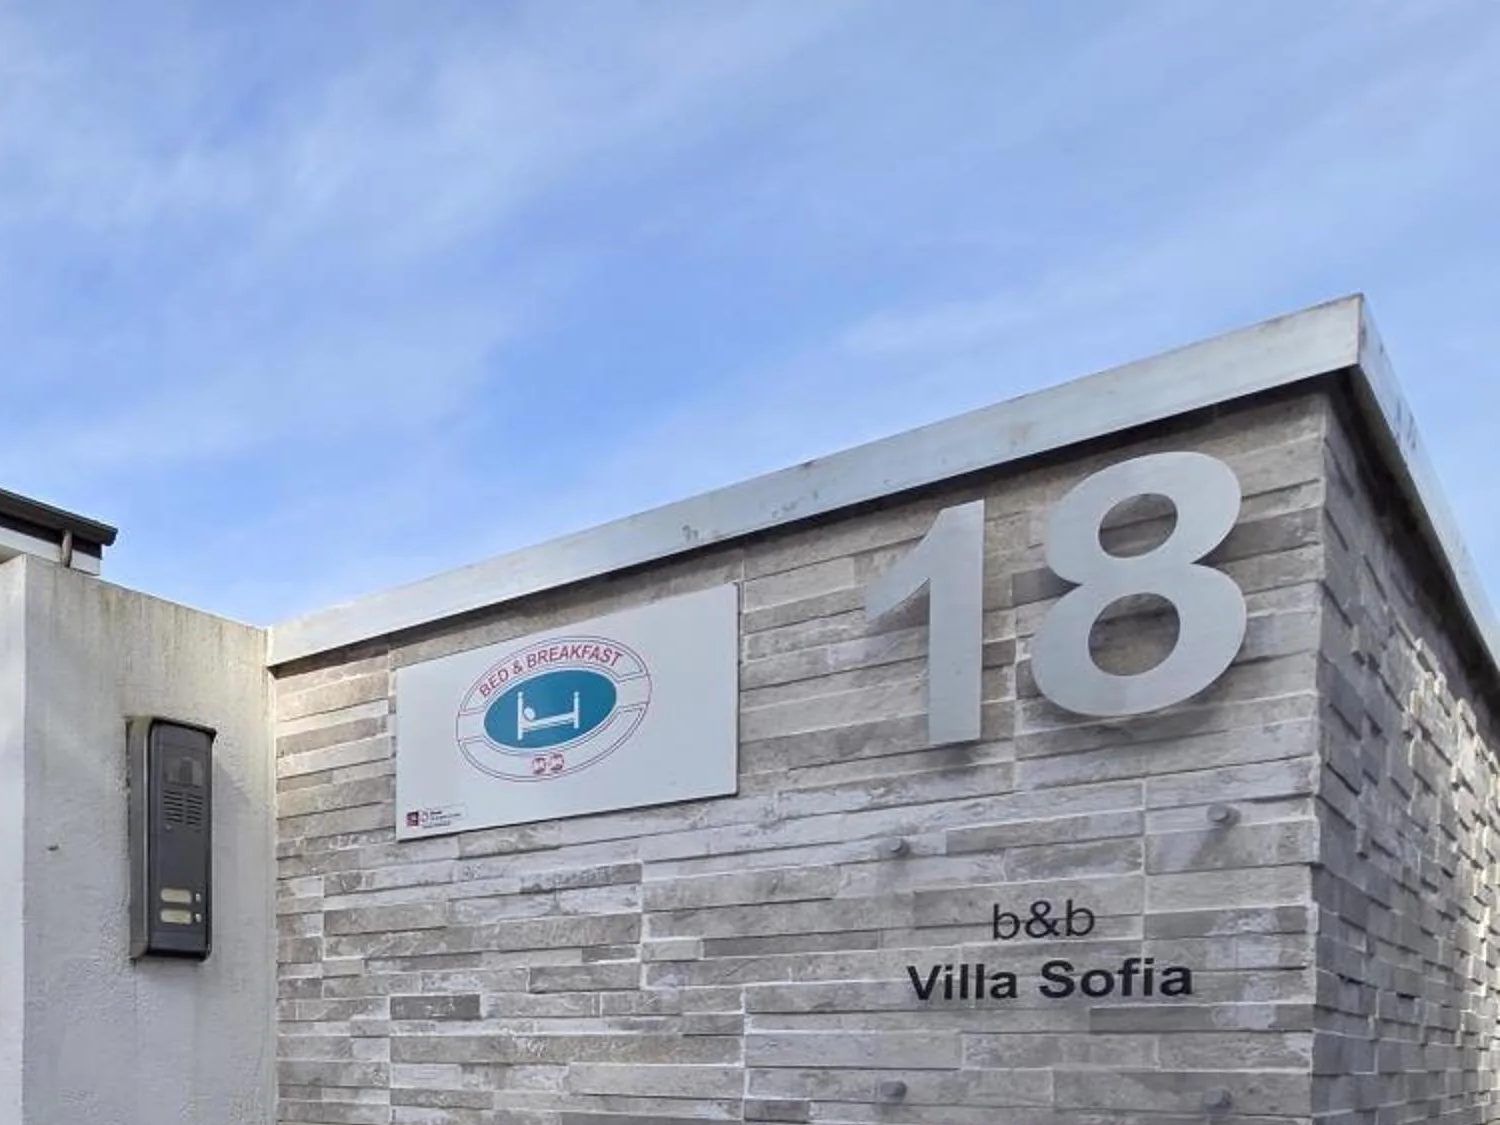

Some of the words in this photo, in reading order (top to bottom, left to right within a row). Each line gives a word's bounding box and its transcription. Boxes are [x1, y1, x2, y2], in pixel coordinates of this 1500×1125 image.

[864, 450, 1248, 746] 18
[479, 668, 509, 697] BED
[513, 660, 523, 674] &
[526, 643, 624, 668] BREAKFAST
[992, 898, 1096, 940] b&b
[906, 962, 1019, 1001] Villa
[1038, 956, 1193, 999] Sofia
